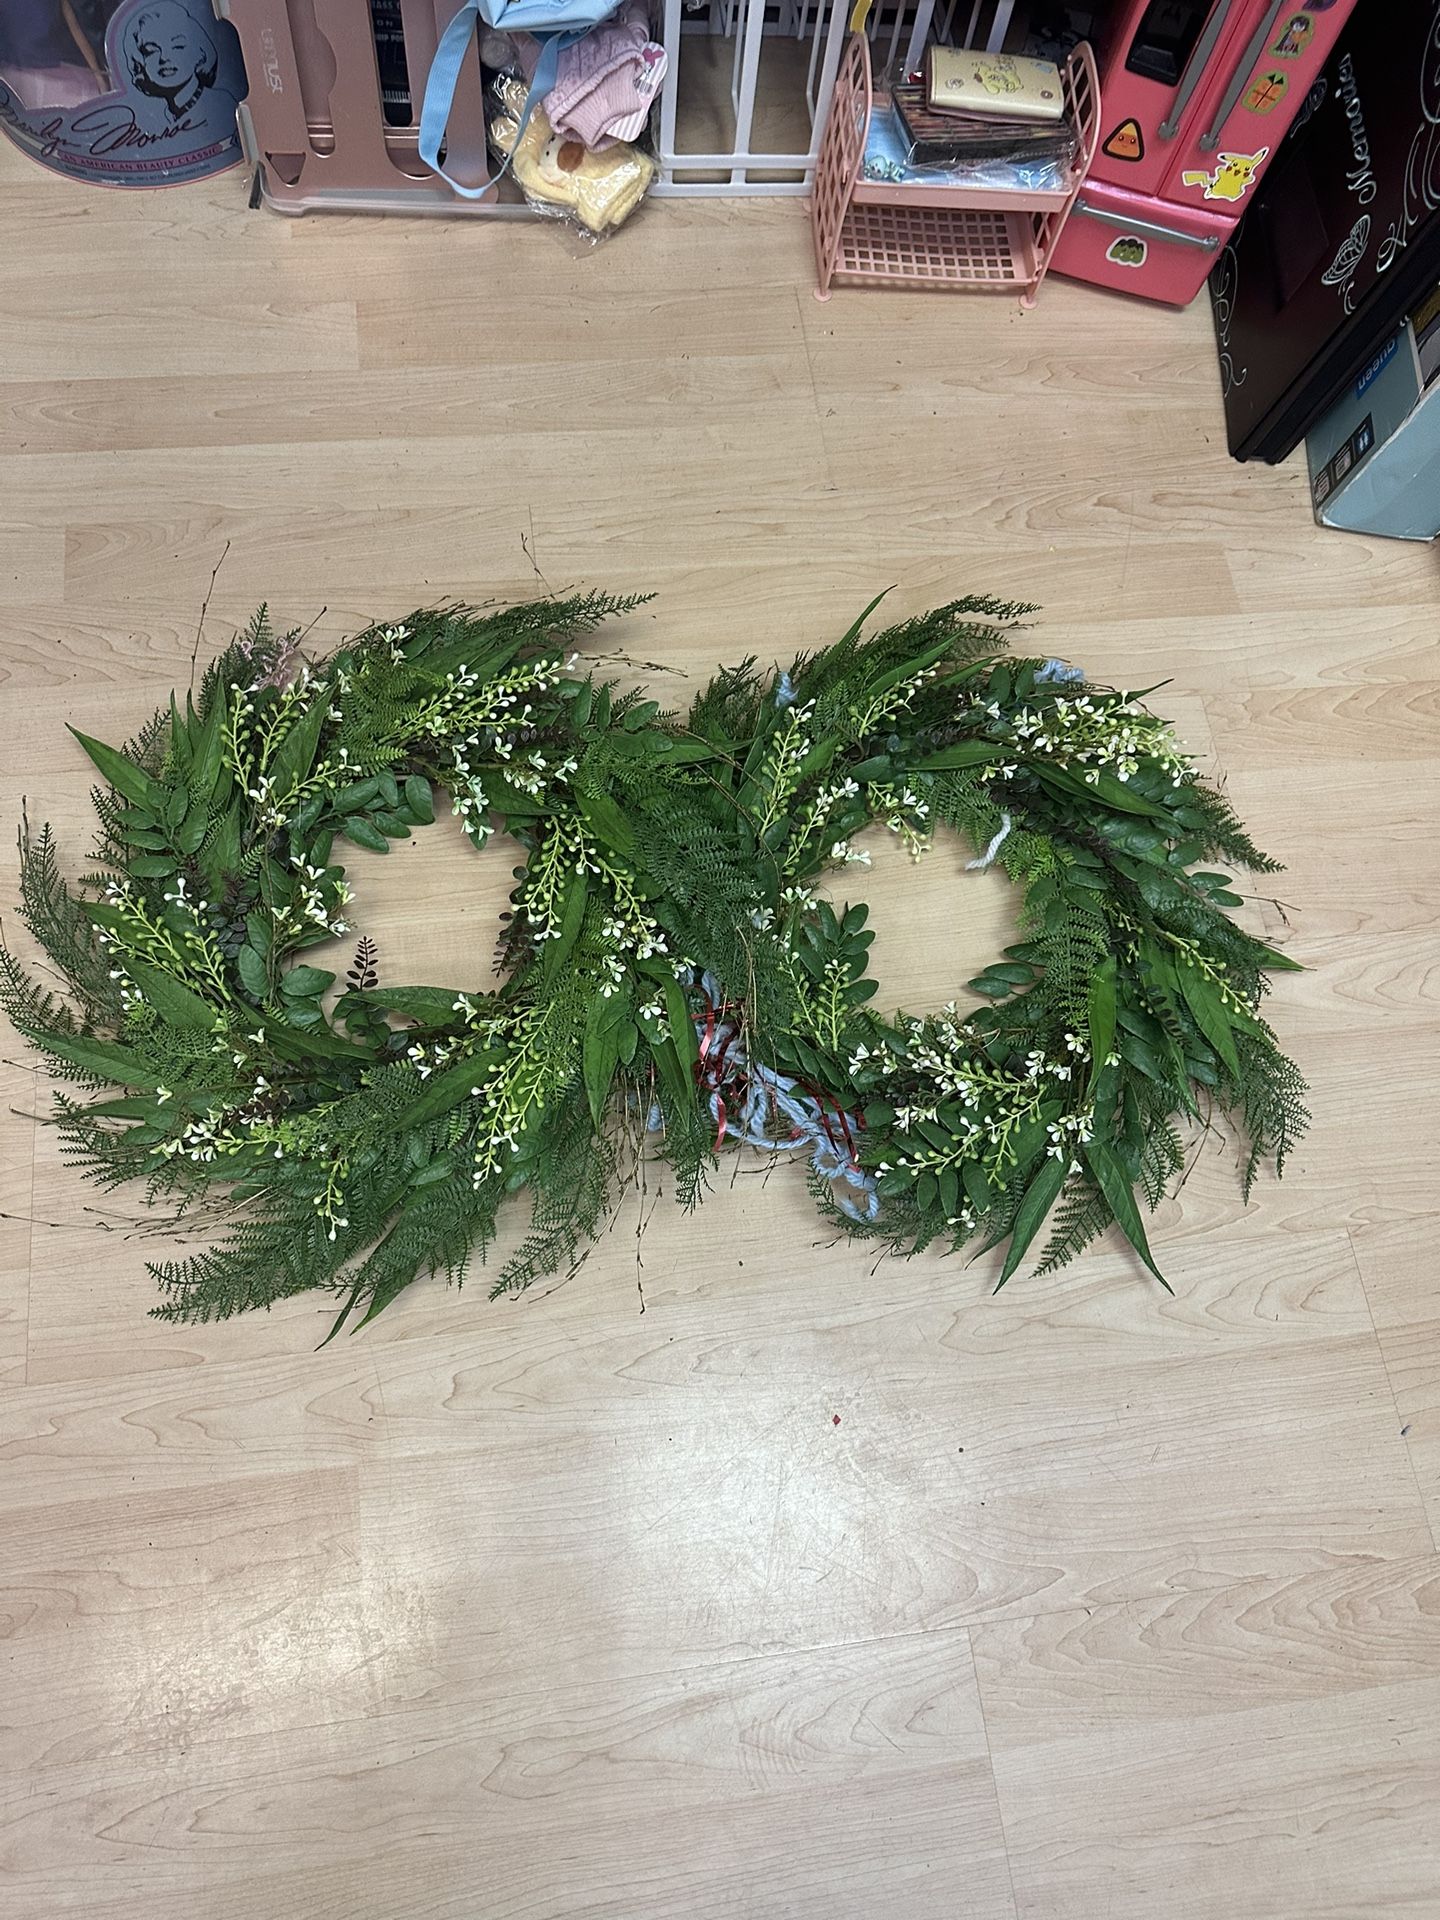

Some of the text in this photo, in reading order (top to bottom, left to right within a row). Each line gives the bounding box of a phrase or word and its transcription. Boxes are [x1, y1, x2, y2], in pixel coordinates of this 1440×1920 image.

[71, 104, 207, 155] Monroe
[64, 147, 218, 170] AN AMERICAN BEAUTY CLASSIC
